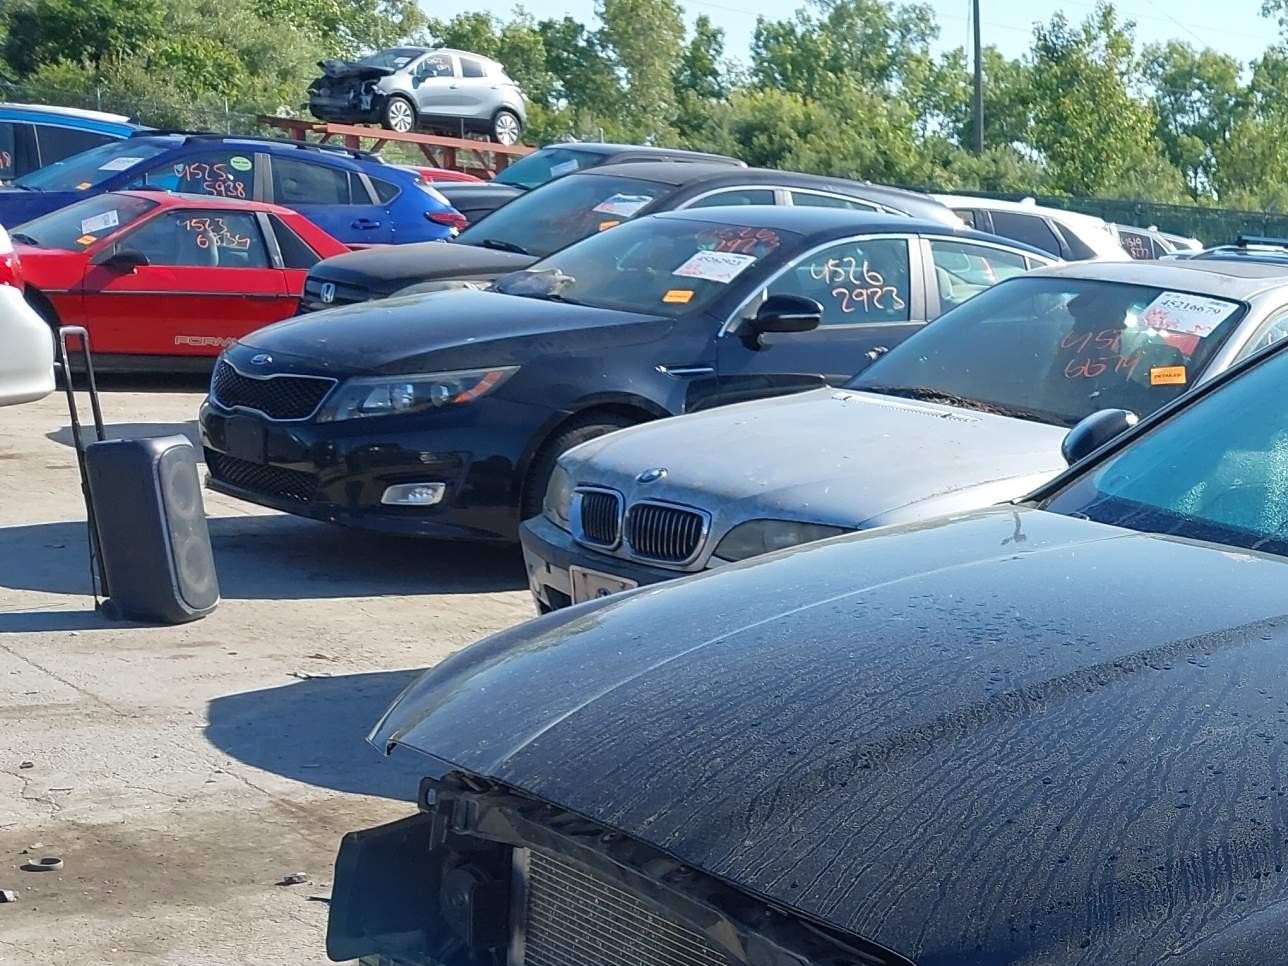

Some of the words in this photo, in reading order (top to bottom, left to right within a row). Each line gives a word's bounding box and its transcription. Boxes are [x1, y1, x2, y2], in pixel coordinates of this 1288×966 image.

[173, 163, 226, 181] 4525
[203, 181, 246, 198] 5938
[810, 256, 884, 285] 4526
[831, 286, 905, 313] 2923
